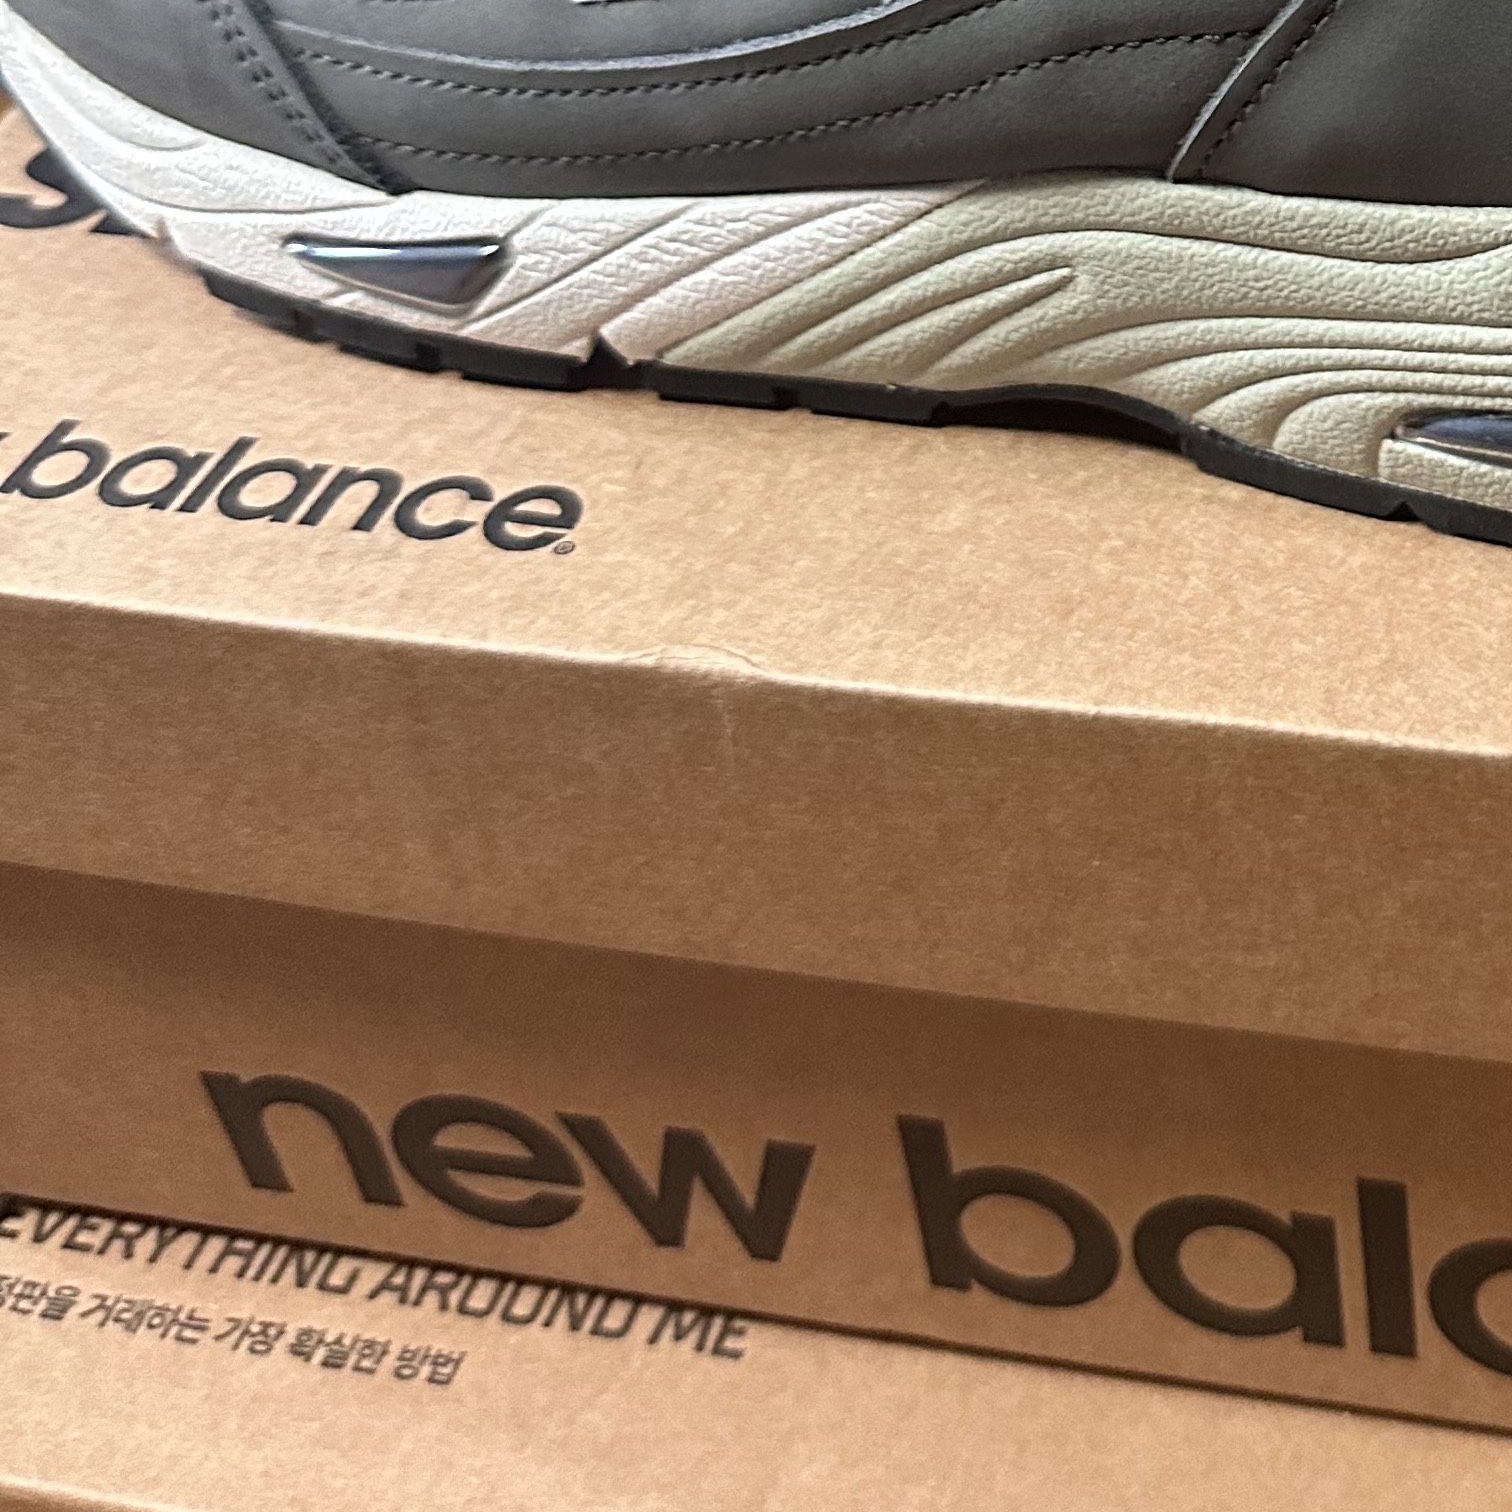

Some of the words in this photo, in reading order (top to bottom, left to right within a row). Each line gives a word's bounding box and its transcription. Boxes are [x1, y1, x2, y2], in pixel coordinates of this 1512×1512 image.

[1, 418, 584, 552] balance
[202, 1069, 816, 1262] new
[78, 1292, 210, 1345] 거래하는
[214, 1315, 287, 1355] 가장
[288, 1325, 392, 1374] 확실한
[394, 1342, 466, 1385] 방법
[368, 1260, 639, 1339] AROUND
[646, 1298, 749, 1360] ME
